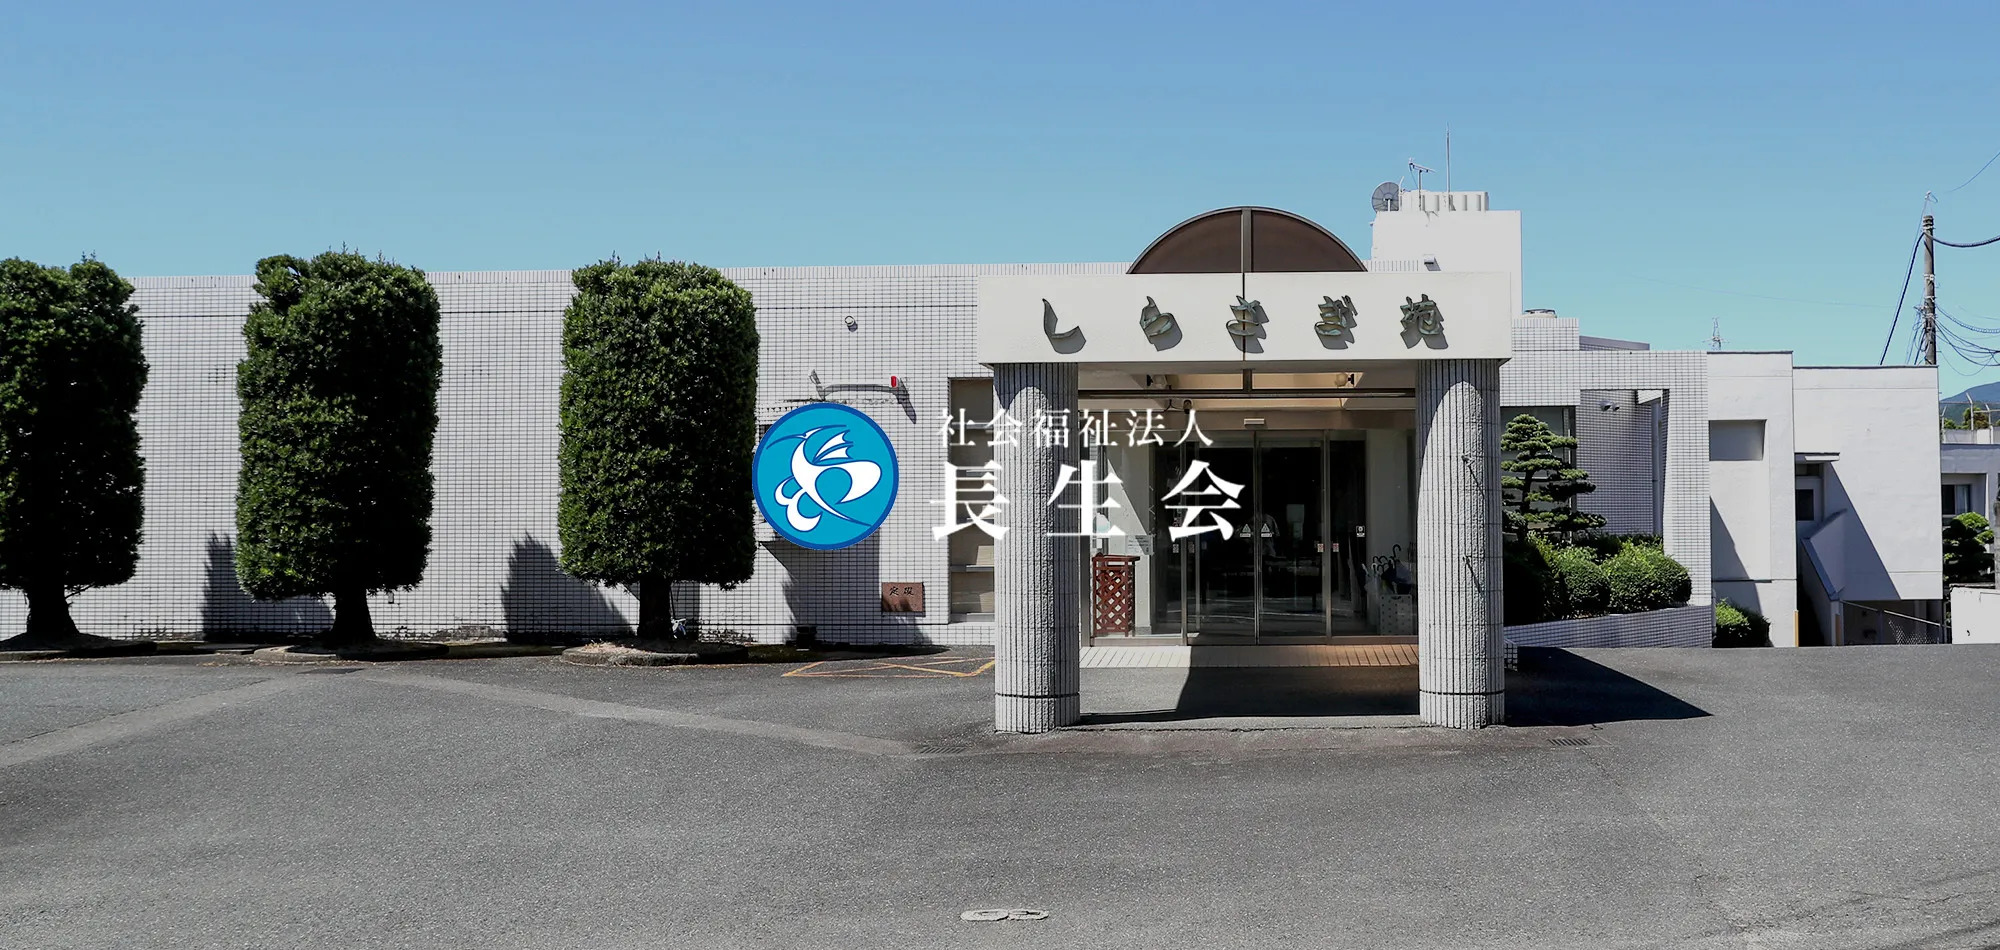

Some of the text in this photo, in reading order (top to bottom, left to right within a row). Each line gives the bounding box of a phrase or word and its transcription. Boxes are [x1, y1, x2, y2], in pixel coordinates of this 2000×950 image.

[1041, 293, 1443, 345] しらさぎ苑
